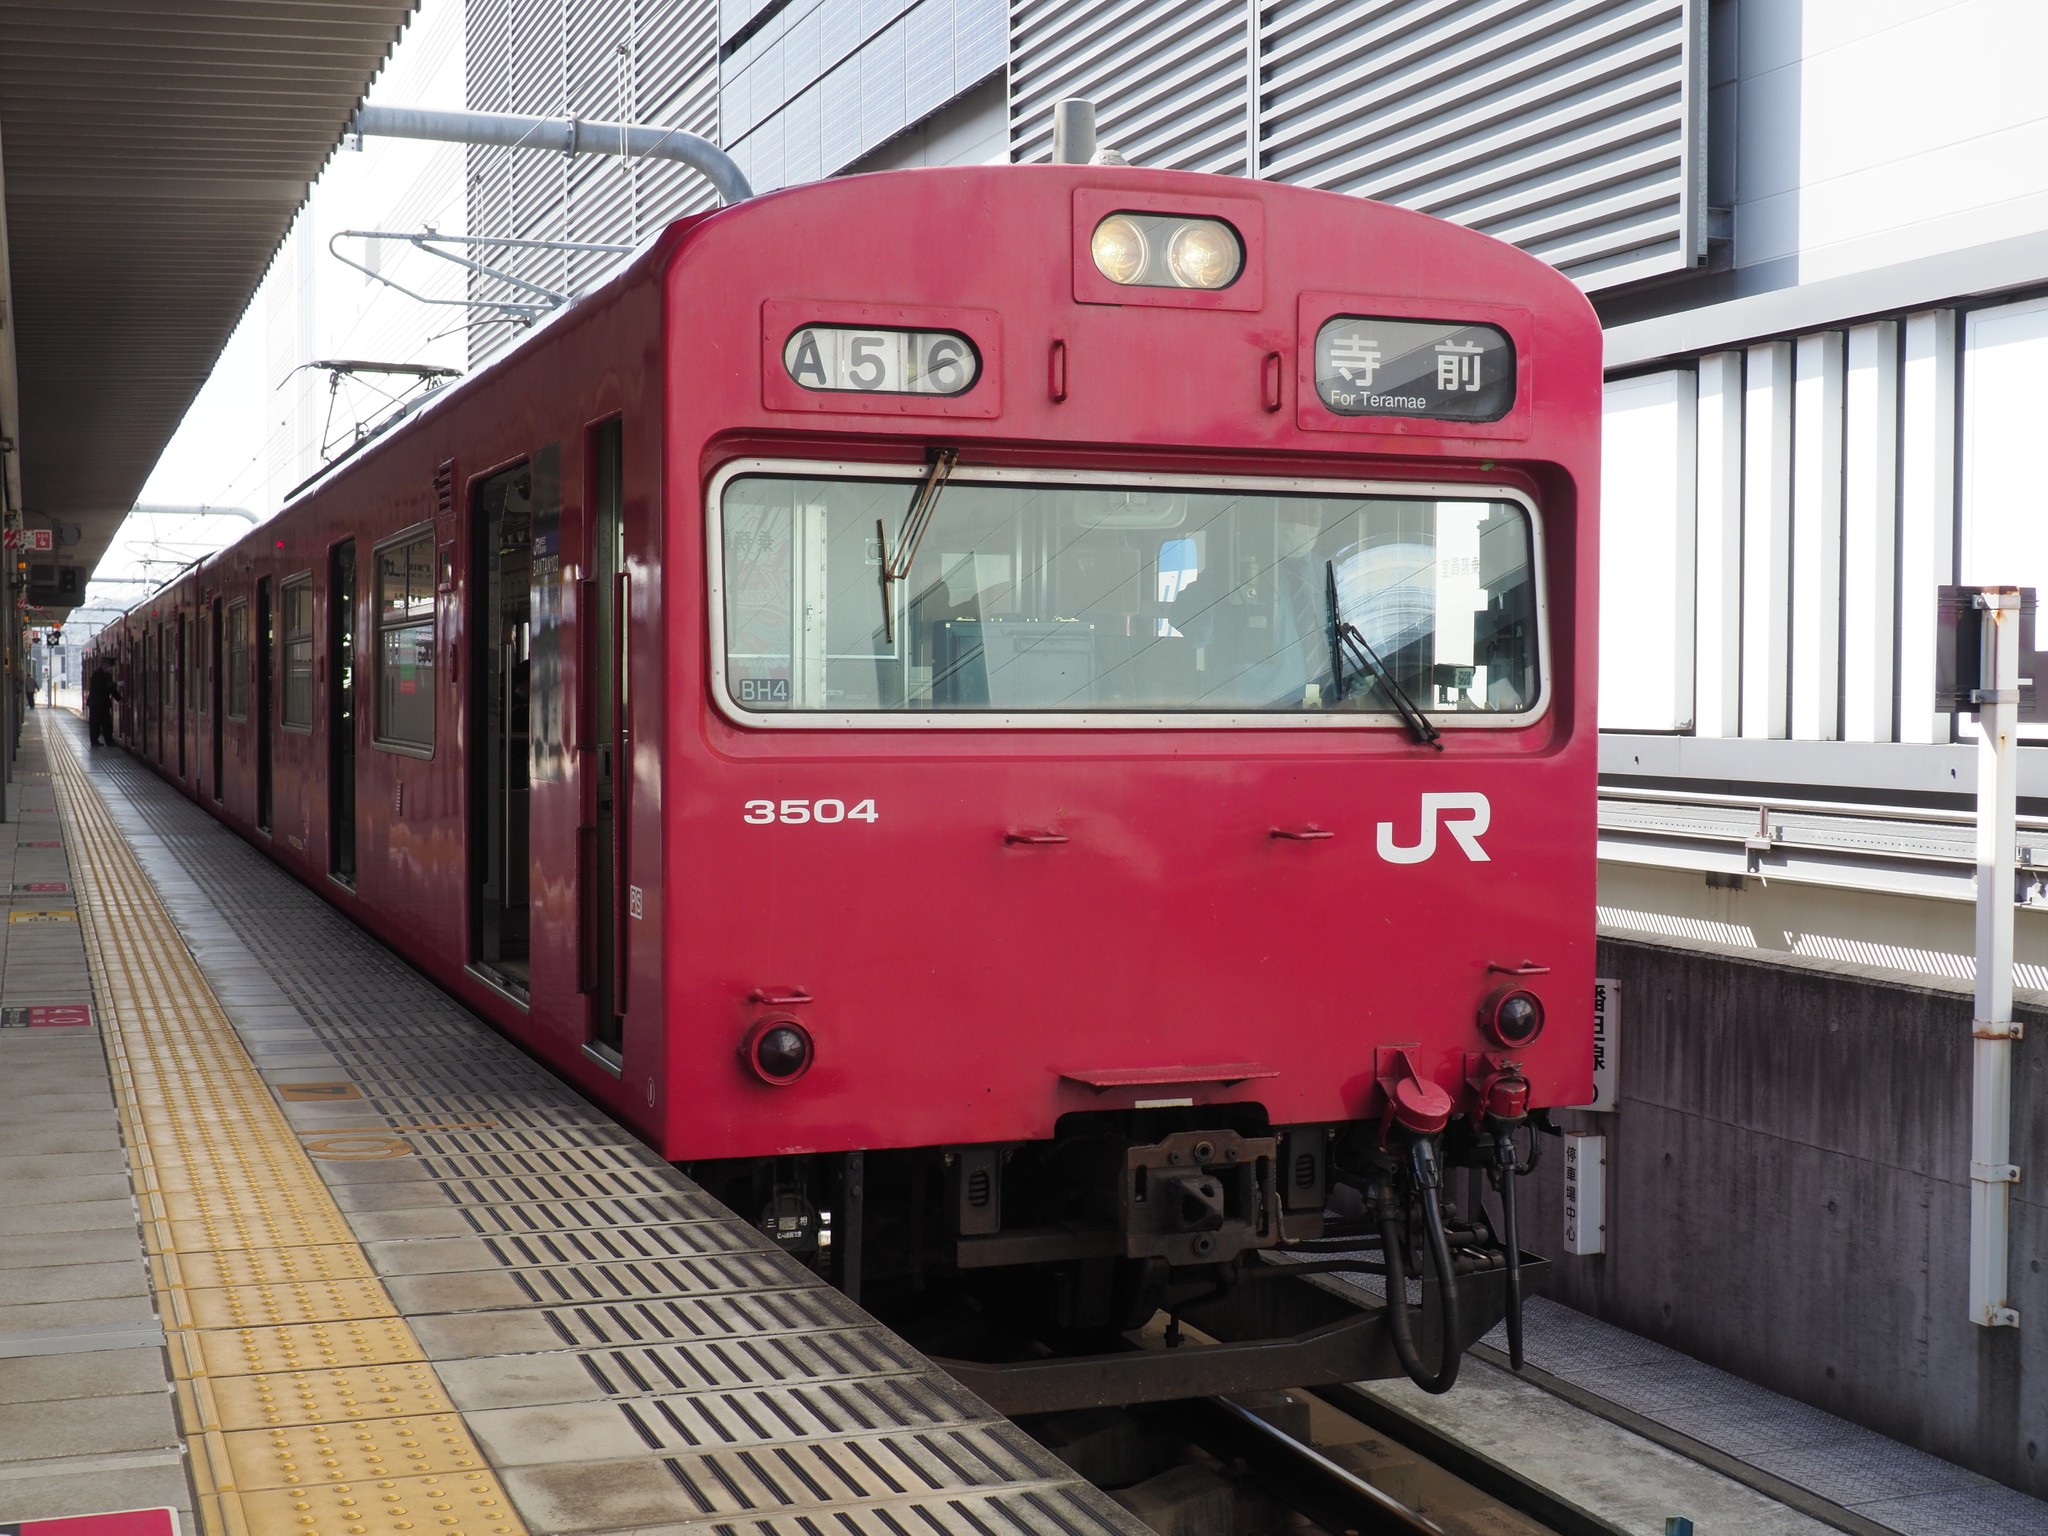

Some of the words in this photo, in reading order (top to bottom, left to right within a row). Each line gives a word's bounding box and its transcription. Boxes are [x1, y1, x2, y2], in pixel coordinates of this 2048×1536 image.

[1331, 390, 1356, 406] For
[1360, 391, 1426, 409] Teramae
[741, 680, 787, 700] BH4
[743, 799, 879, 824] 3504
[1376, 792, 1492, 864] JR
[1566, 1146, 1576, 1242] 停車場中心
